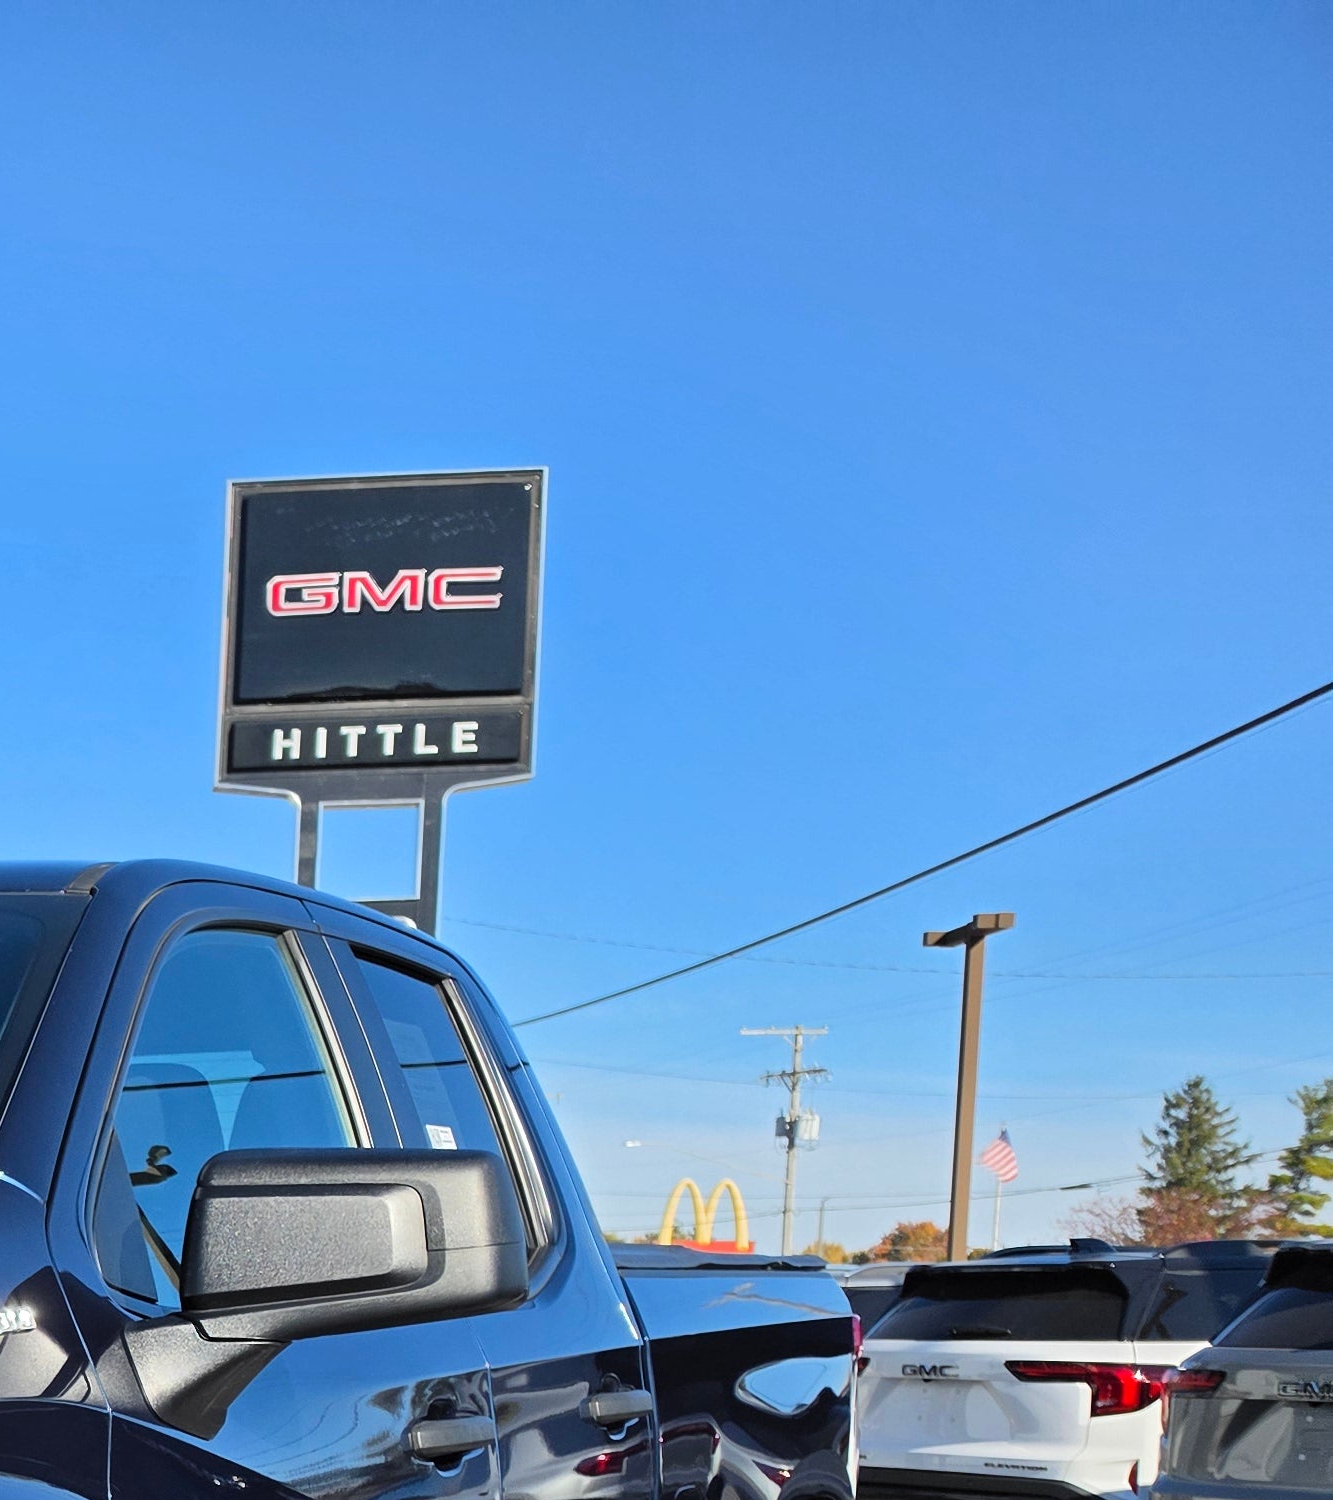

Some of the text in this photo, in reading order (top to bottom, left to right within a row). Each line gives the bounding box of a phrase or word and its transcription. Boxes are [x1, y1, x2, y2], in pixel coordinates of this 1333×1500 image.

[266, 566, 504, 617] GMC
[270, 721, 479, 760] HITTLE
[901, 1364, 960, 1378] GMC
